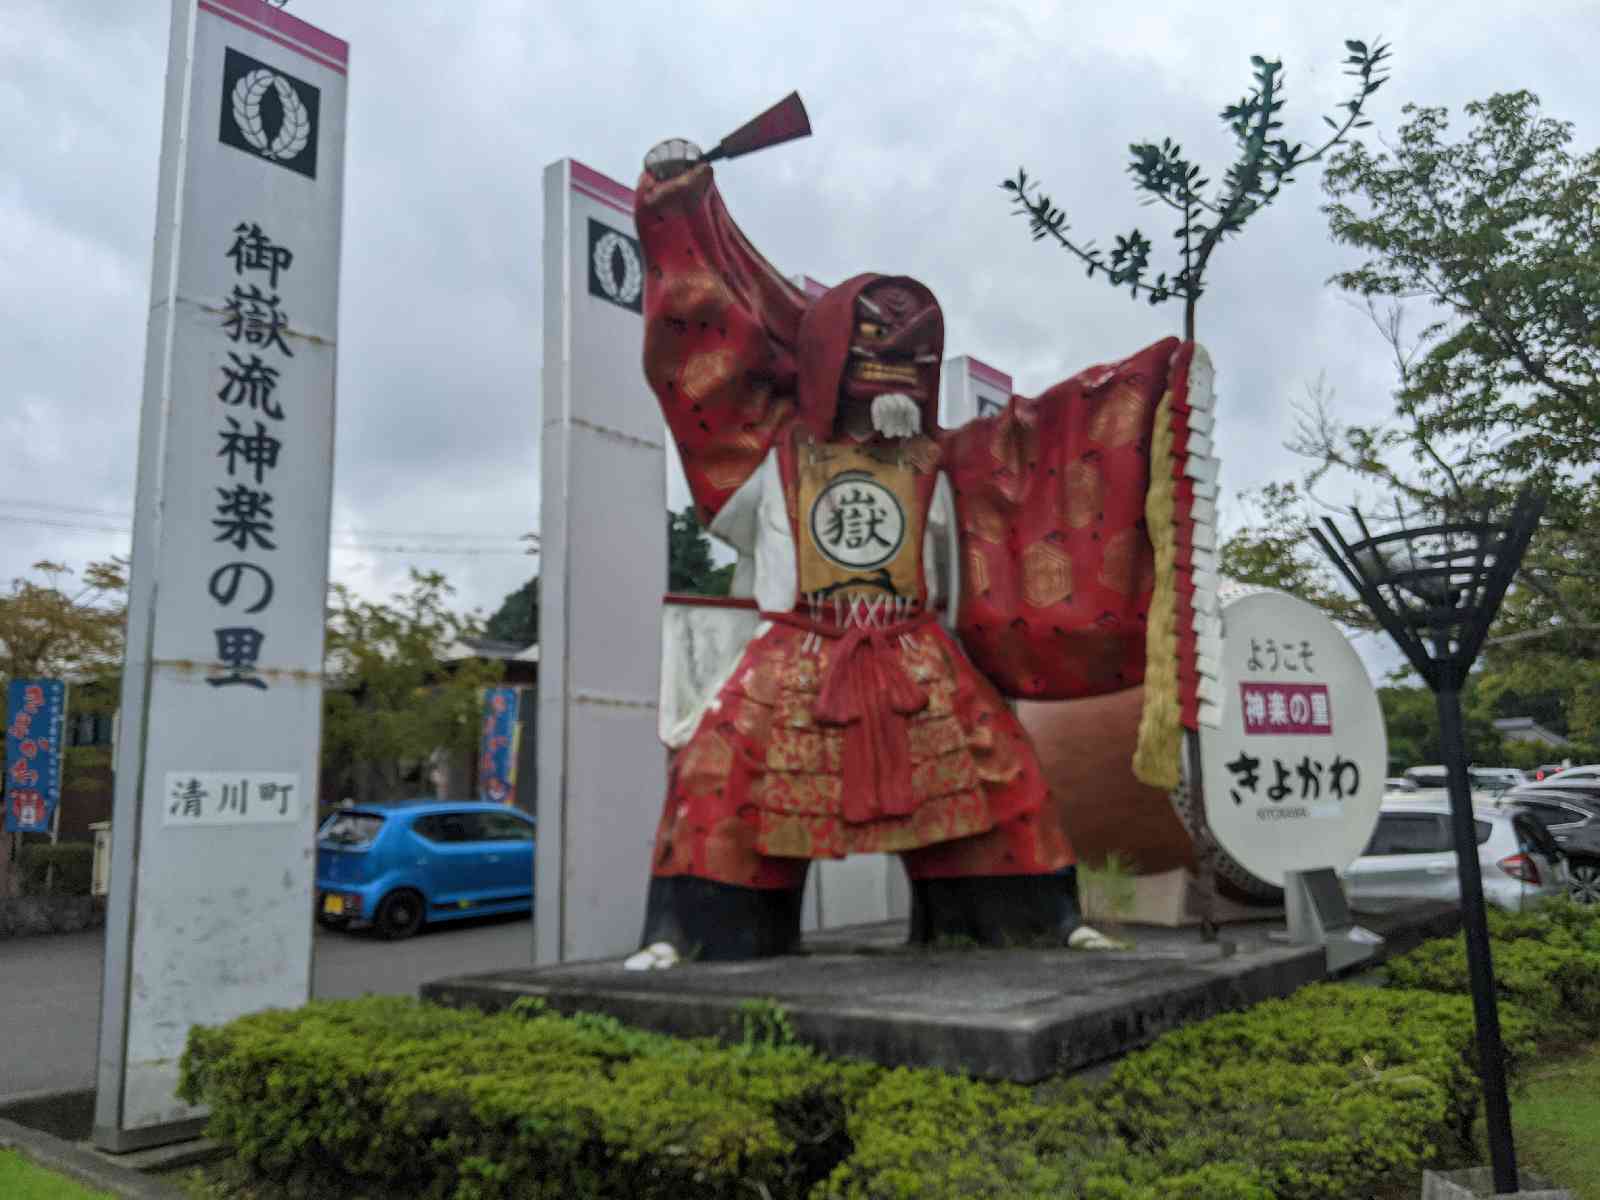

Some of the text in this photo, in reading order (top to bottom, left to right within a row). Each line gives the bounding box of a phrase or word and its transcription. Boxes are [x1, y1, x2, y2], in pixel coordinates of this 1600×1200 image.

[205, 222, 295, 690] 御嶽流神楽の里
[823, 488, 892, 549] 嶽
[1248, 638, 1315, 673] ようこそ
[1244, 690, 1330, 727] 神楽の里
[169, 777, 295, 818] 清川町
[1225, 751, 1360, 808] きよかわ
